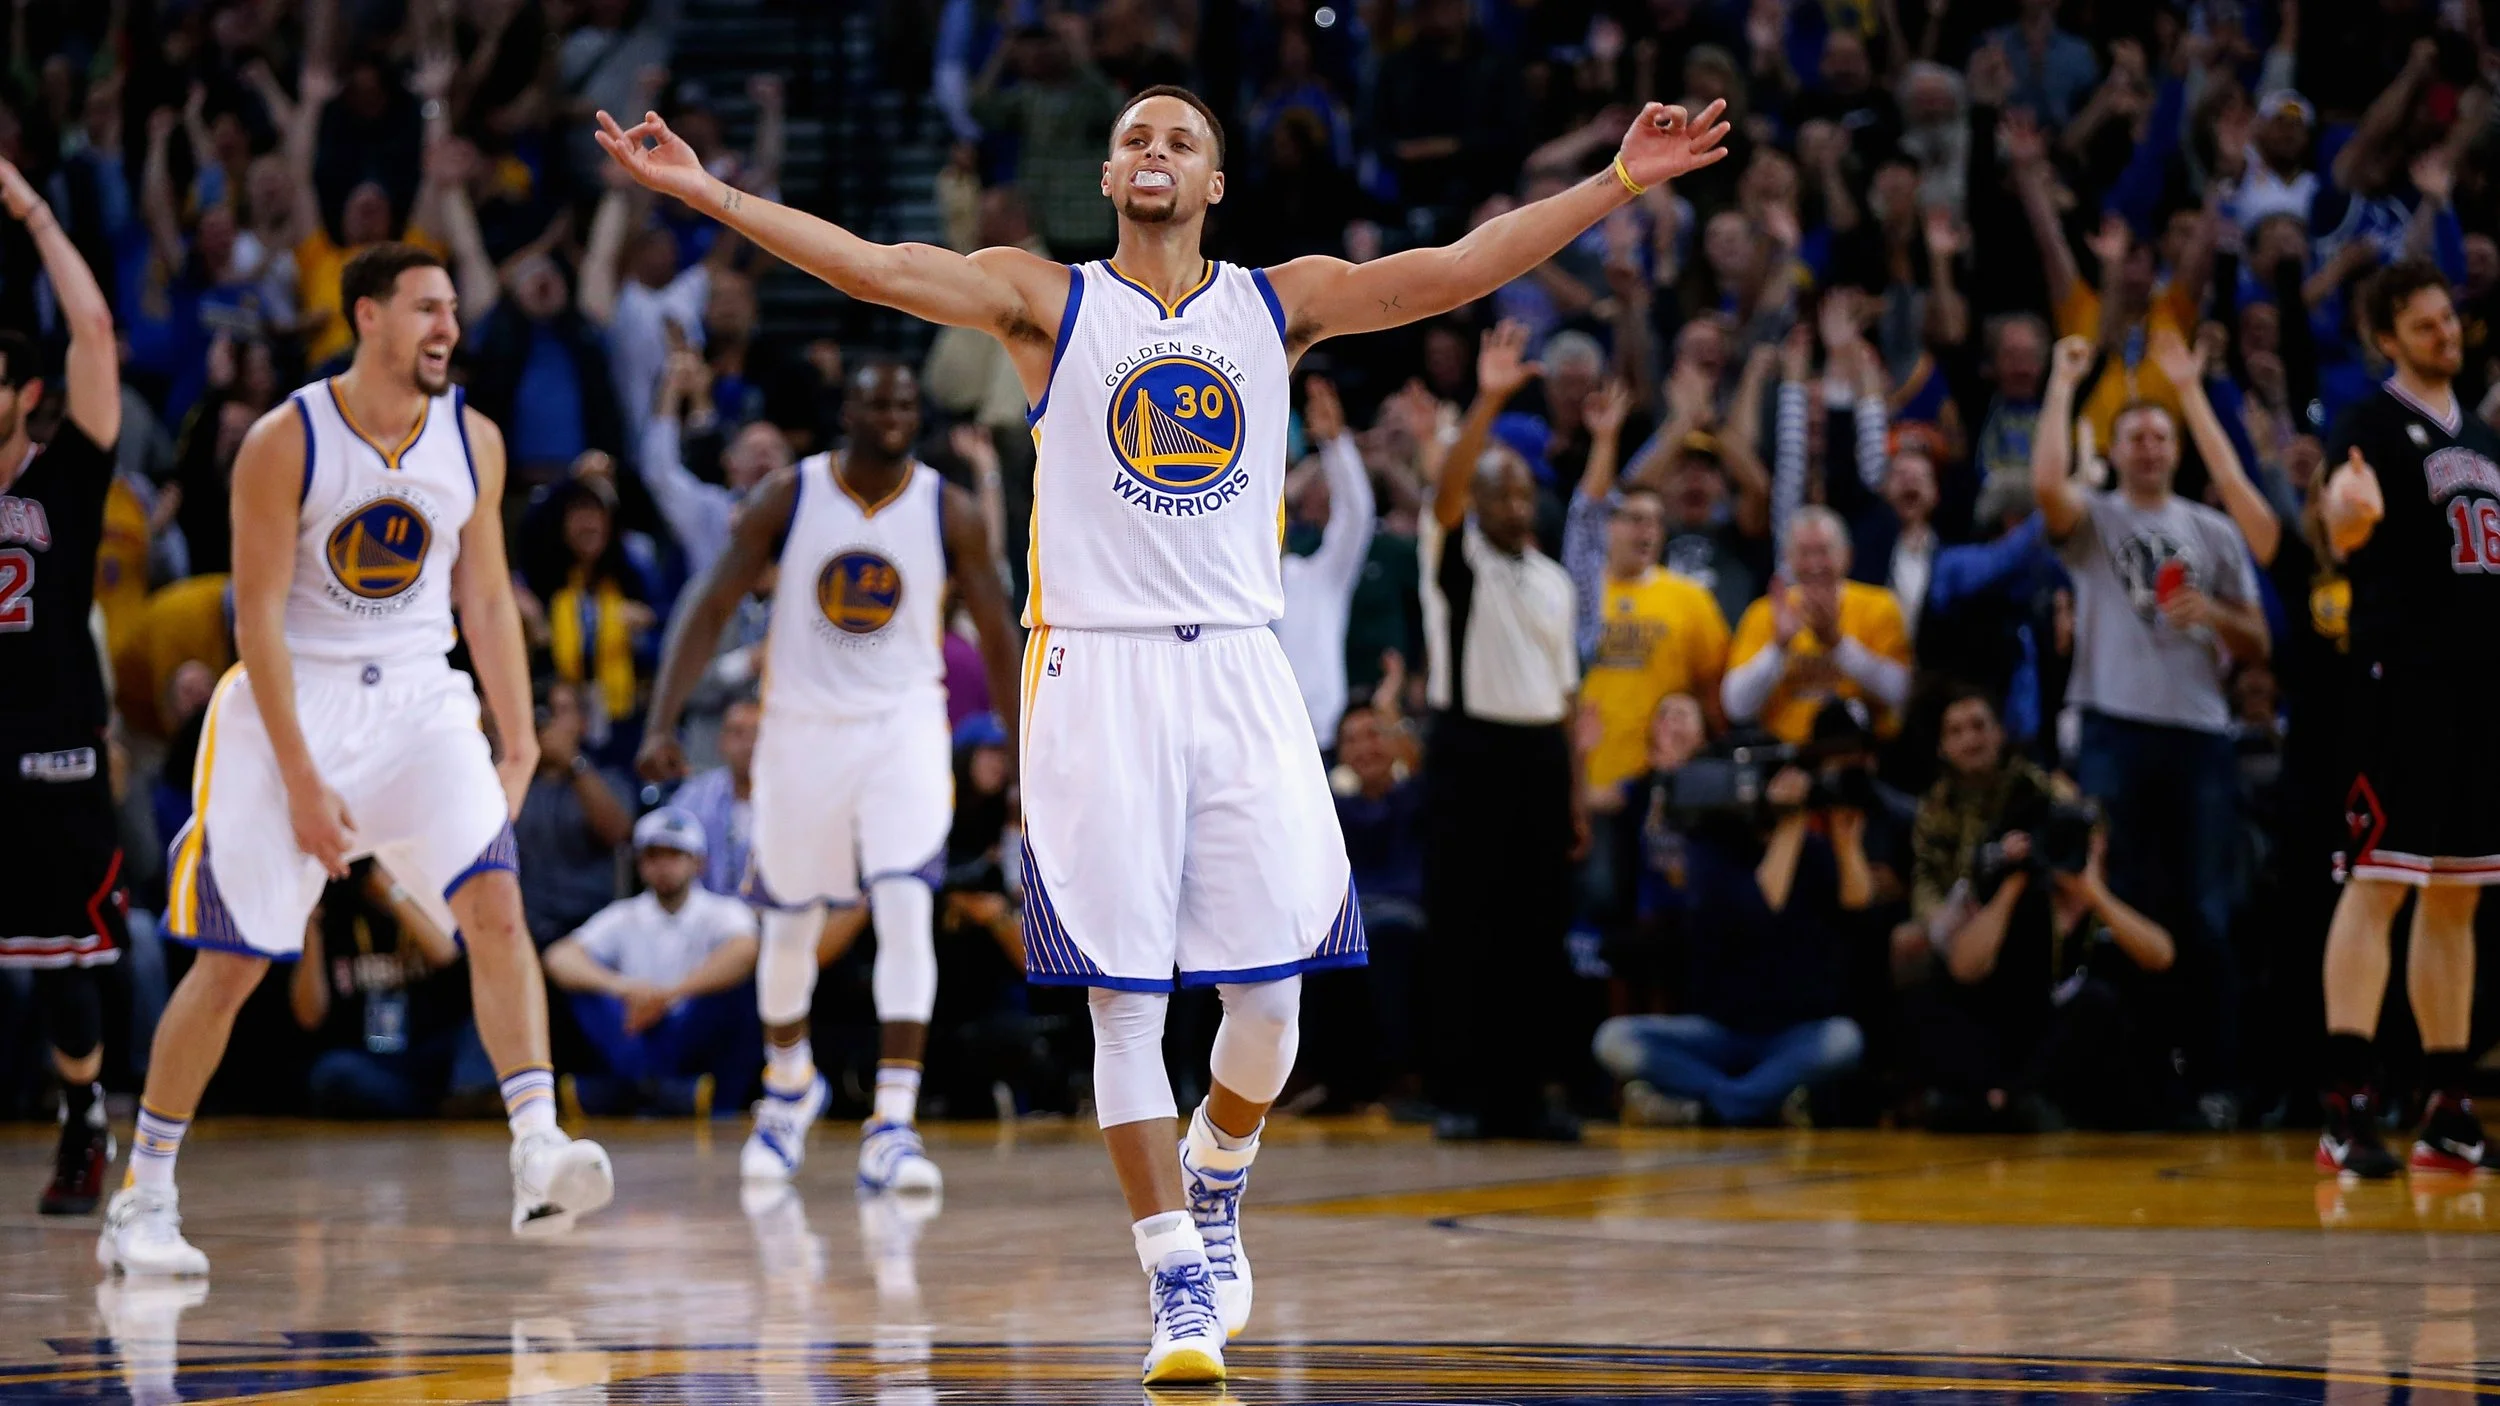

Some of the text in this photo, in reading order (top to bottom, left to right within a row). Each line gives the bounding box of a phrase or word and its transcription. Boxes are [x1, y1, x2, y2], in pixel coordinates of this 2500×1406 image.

[1105, 342, 1246, 387] GOLDEN STATE
[1173, 384, 1225, 420] 30
[1112, 468, 1250, 517] WARRIORS
[384, 515, 410, 544] 11
[2446, 496, 2500, 574] 16
